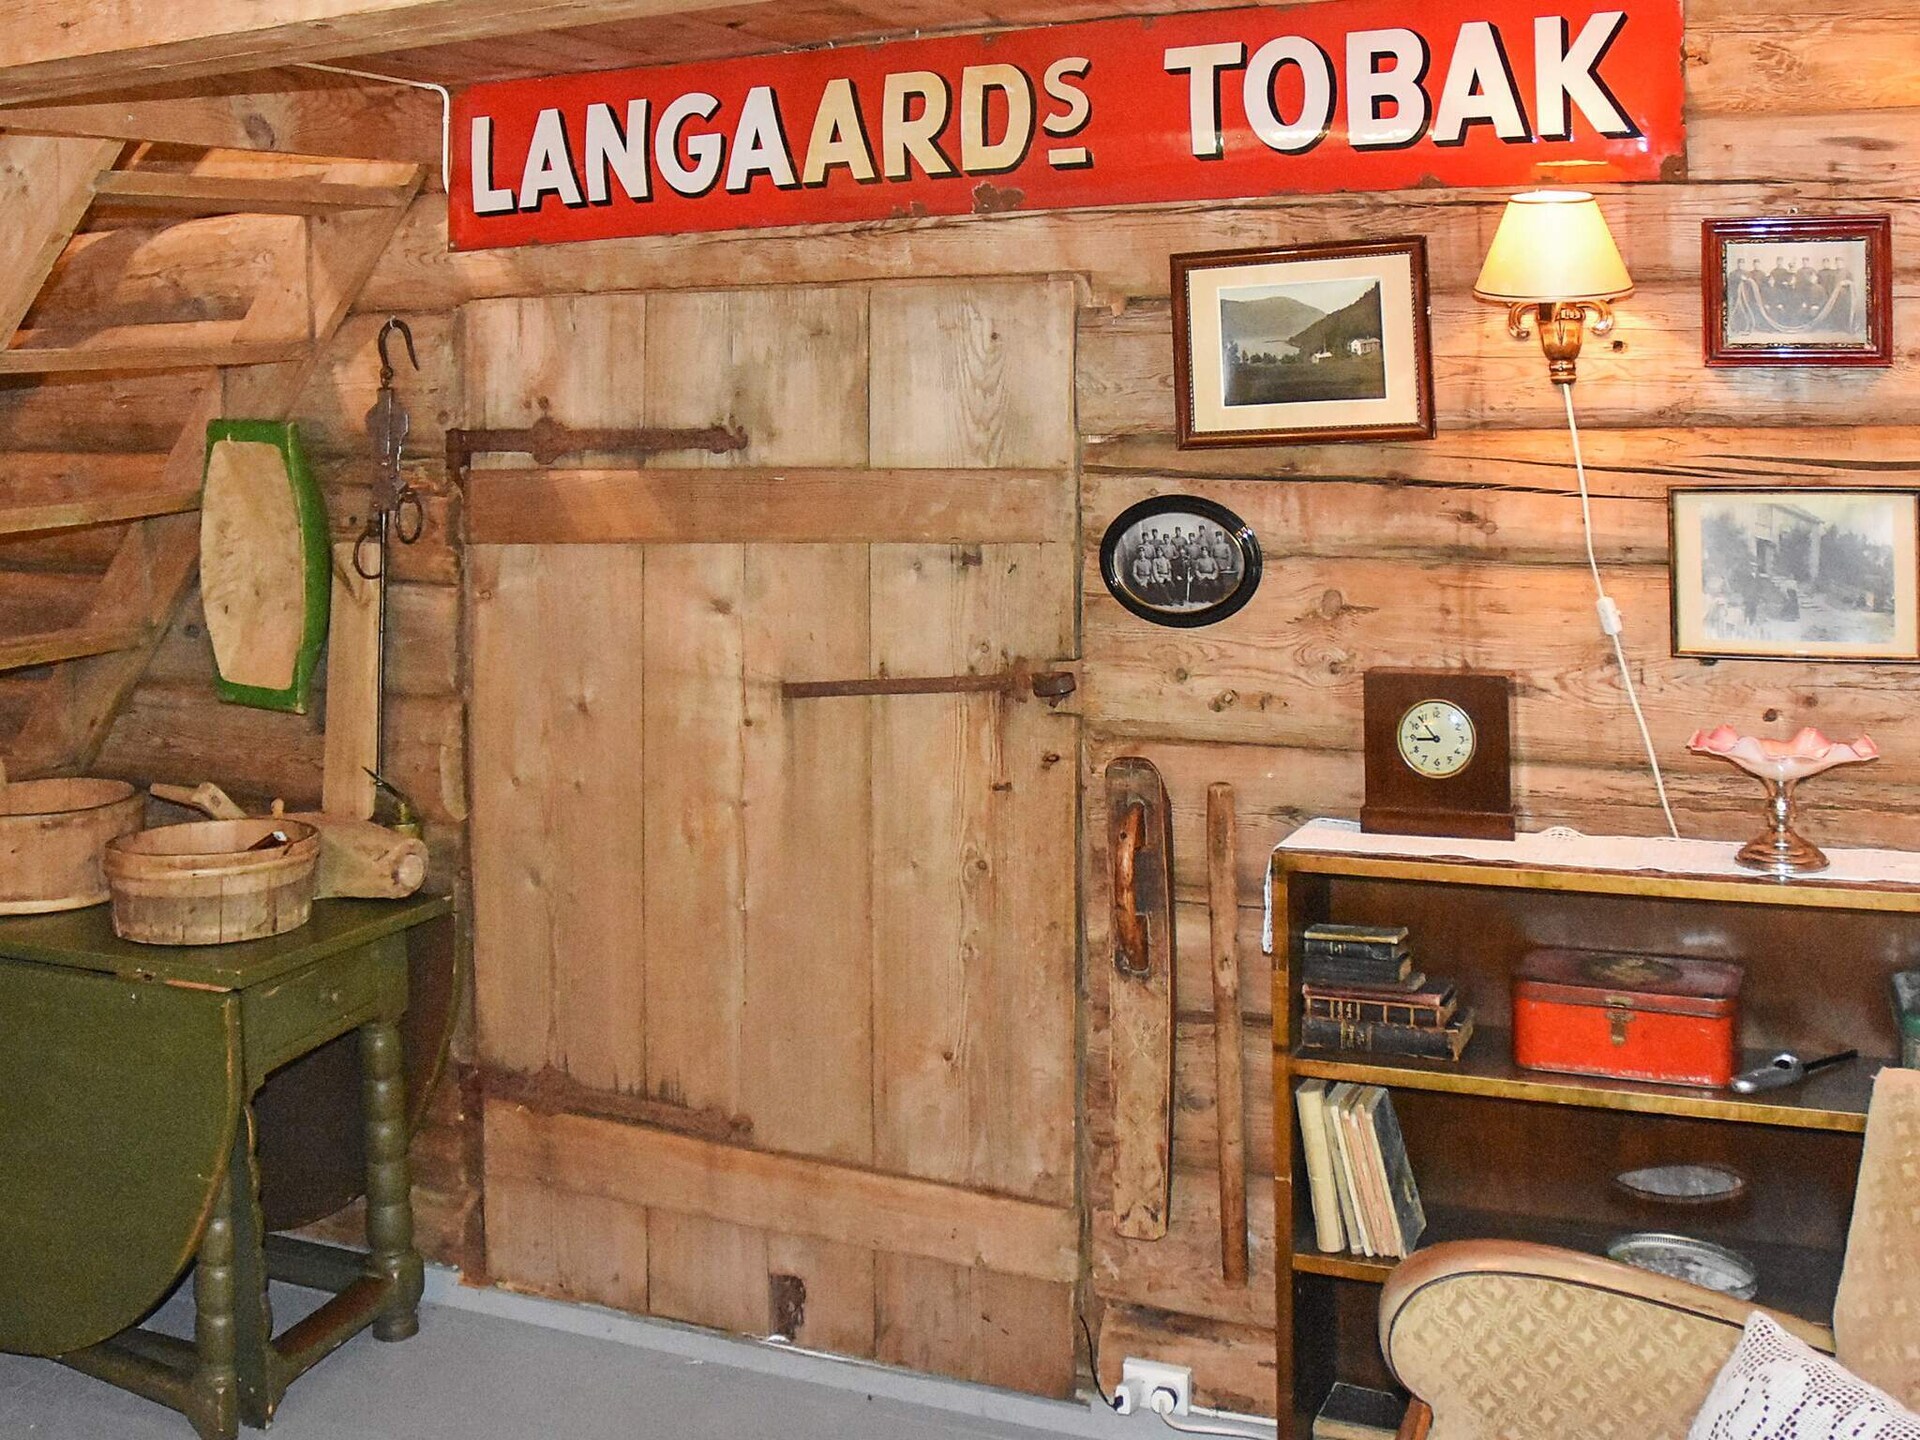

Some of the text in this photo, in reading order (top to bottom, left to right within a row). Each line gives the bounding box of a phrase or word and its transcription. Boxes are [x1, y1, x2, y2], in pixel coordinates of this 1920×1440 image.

[1163, 11, 1638, 158] TOBAK
[1433, 710, 1440, 719] 12
[1409, 734, 1417, 742] 9
[1413, 745, 1420, 753] 8
[1421, 755, 1428, 763] 7
[1433, 758, 1441, 766] 6
[1446, 756, 1453, 764] 5
